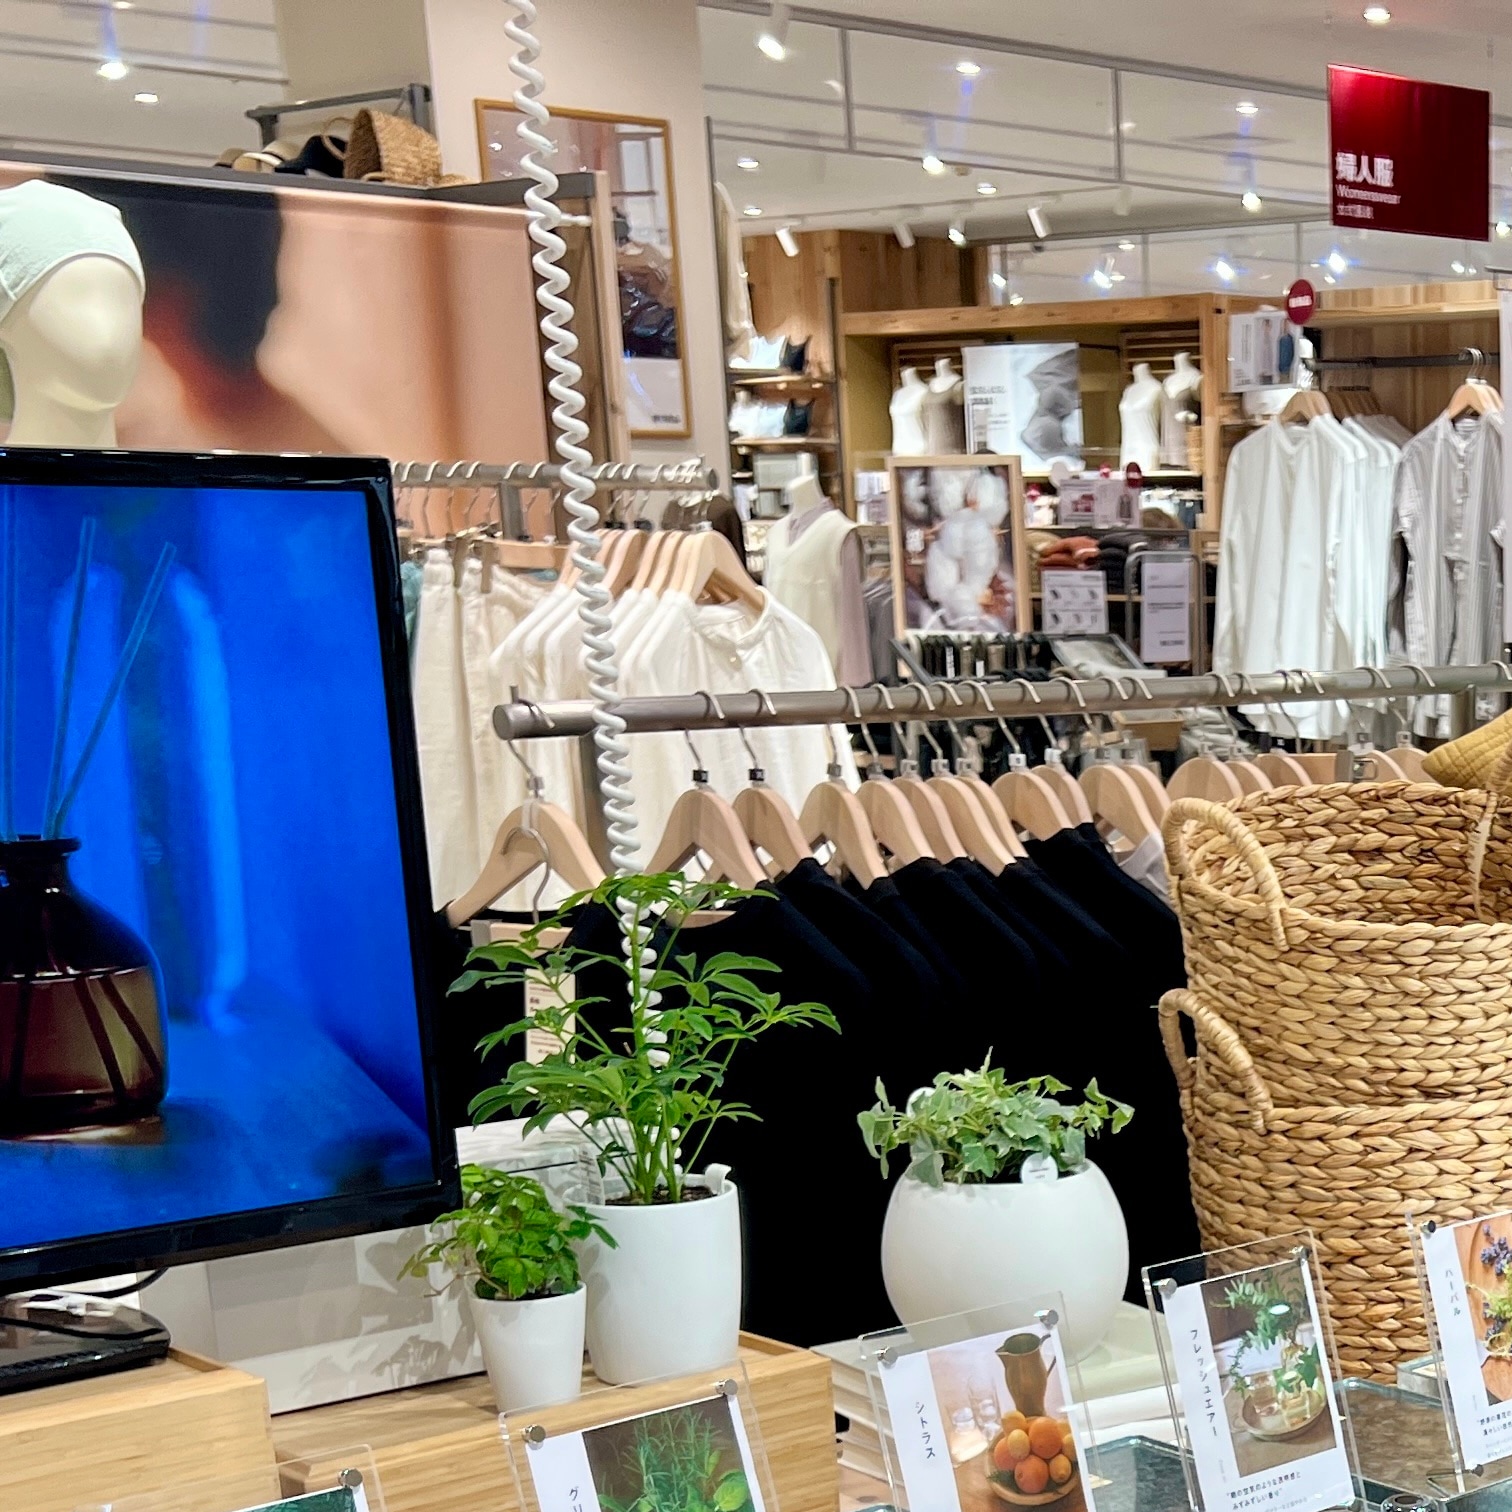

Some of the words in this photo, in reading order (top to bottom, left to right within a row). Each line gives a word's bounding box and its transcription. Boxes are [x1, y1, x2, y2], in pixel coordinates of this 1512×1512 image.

[1335, 151, 1394, 187] 婦人服
[1190, 1329, 1218, 1437] フレッシュエアー
[915, 1401, 937, 1460] シトラス
